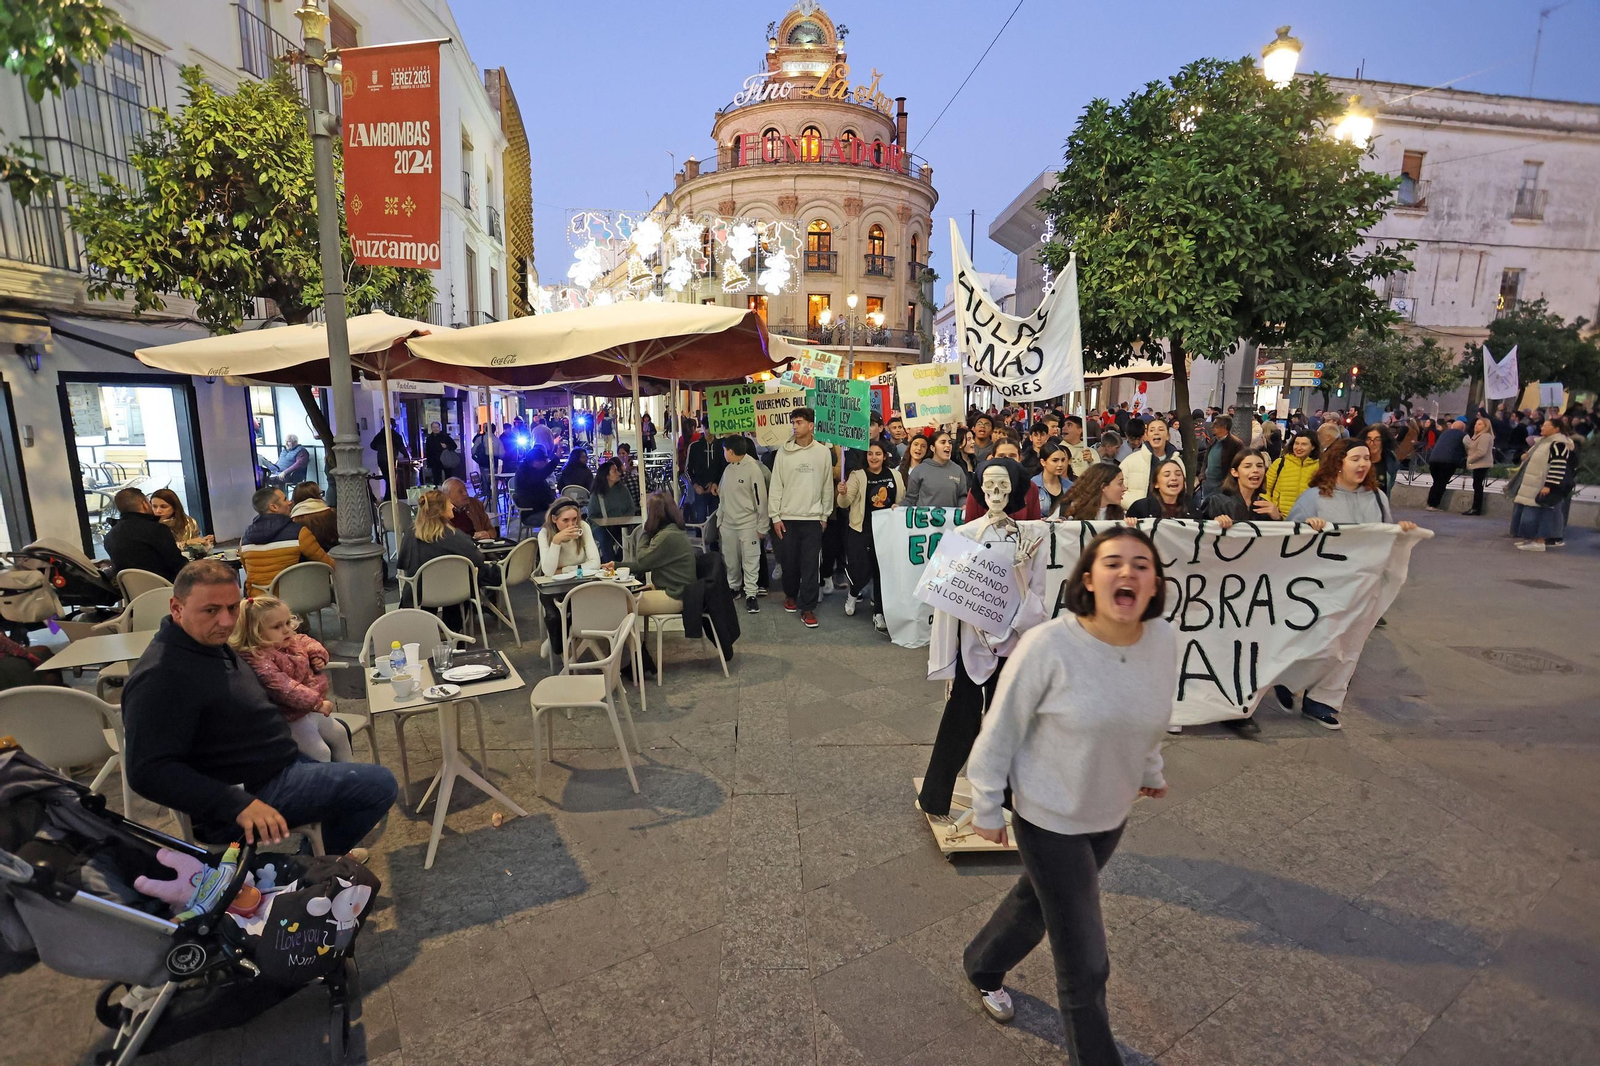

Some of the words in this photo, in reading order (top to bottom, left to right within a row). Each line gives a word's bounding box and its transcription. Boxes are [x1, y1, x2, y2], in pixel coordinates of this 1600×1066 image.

[391, 71, 413, 86] JEREZ
[413, 70, 431, 84] 2031
[733, 70, 796, 107] Fino
[800, 62, 850, 100] La
[349, 120, 430, 148] ZAMBOMBAS
[394, 150, 432, 174] 2024
[738, 132, 905, 174] FUNDADOR
[350, 232, 440, 265] Cruzcampo
[713, 389, 729, 407] 14
[731, 385, 765, 397] AÑOS
[996, 379, 1042, 397] LORES
[722, 405, 754, 418] FALSAS
[756, 397, 791, 410] QUEREMOS
[817, 393, 828, 407] QUE
[757, 415, 767, 427] NO
[827, 409, 836, 422] LA
[906, 507, 946, 529] IES
[1280, 521, 1348, 561] DE
[948, 559, 1009, 594] ESPERANDO
[967, 553, 978, 564] 14
[978, 559, 1007, 578] AÑOS
[936, 569, 949, 582] LA
[950, 576, 1008, 609] EDUCACIÓN
[927, 580, 943, 594] EN
[942, 588, 964, 605] LOS
[964, 599, 1004, 623] HUESOS
[288, 953, 316, 967] Mom
